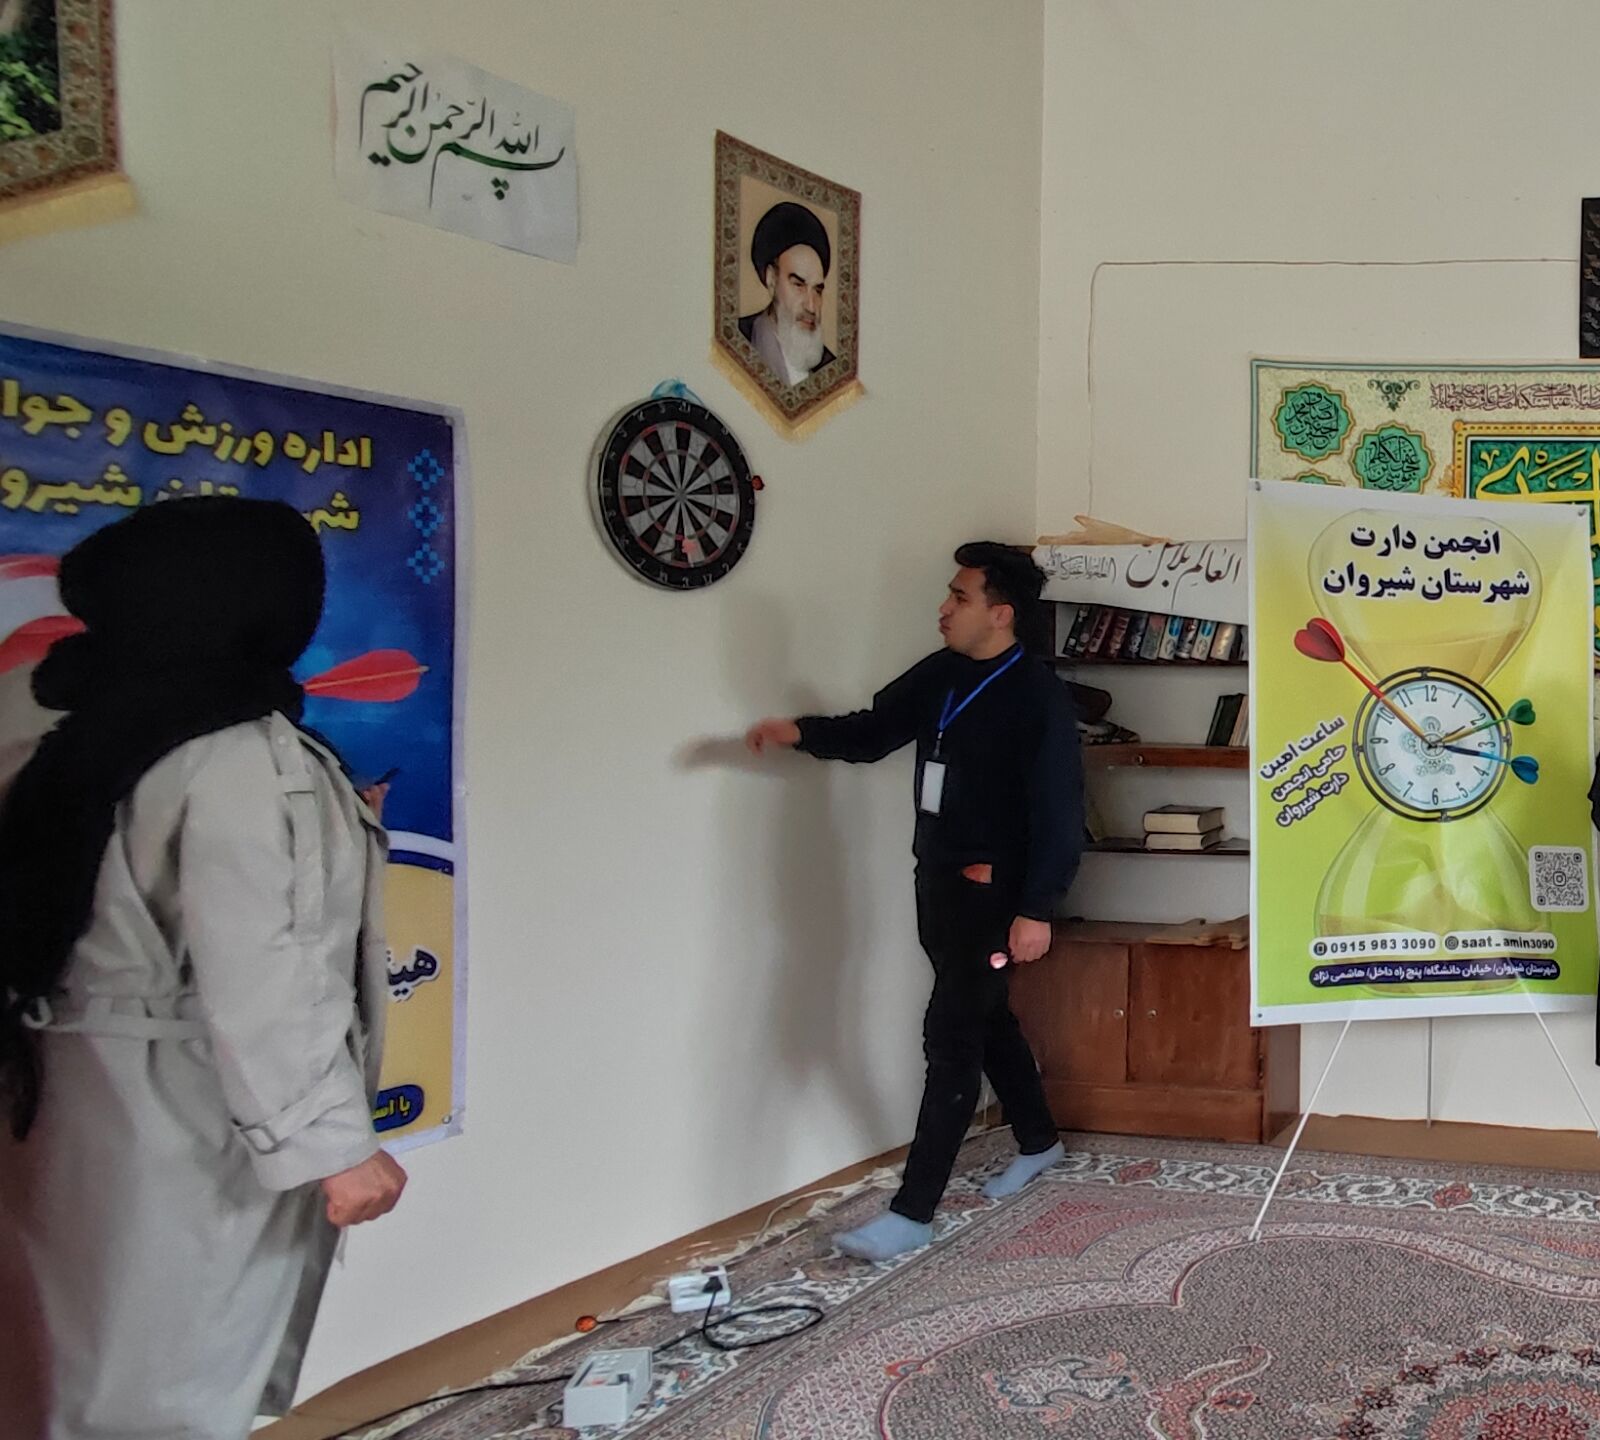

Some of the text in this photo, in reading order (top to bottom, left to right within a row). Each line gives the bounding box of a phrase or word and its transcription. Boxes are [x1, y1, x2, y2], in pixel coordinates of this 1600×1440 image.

[105, 407, 132, 446] و
[143, 404, 274, 466] ورزش
[283, 431, 372, 473] اداره
[1350, 525, 1500, 561] انجمن دارت
[1323, 562, 1530, 603] شهرستان شیروان
[1397, 688, 1413, 708] 11
[1425, 685, 1437, 702] 12
[1260, 717, 1345, 779] ساعت امین
[1272, 745, 1347, 801] حامی انجمن
[1277, 773, 1349, 827] دارت شیروان
[1431, 788, 1439, 806] 6
[1330, 938, 1436, 953] 0915 983 3090
[1462, 963, 1491, 977] خیابان
